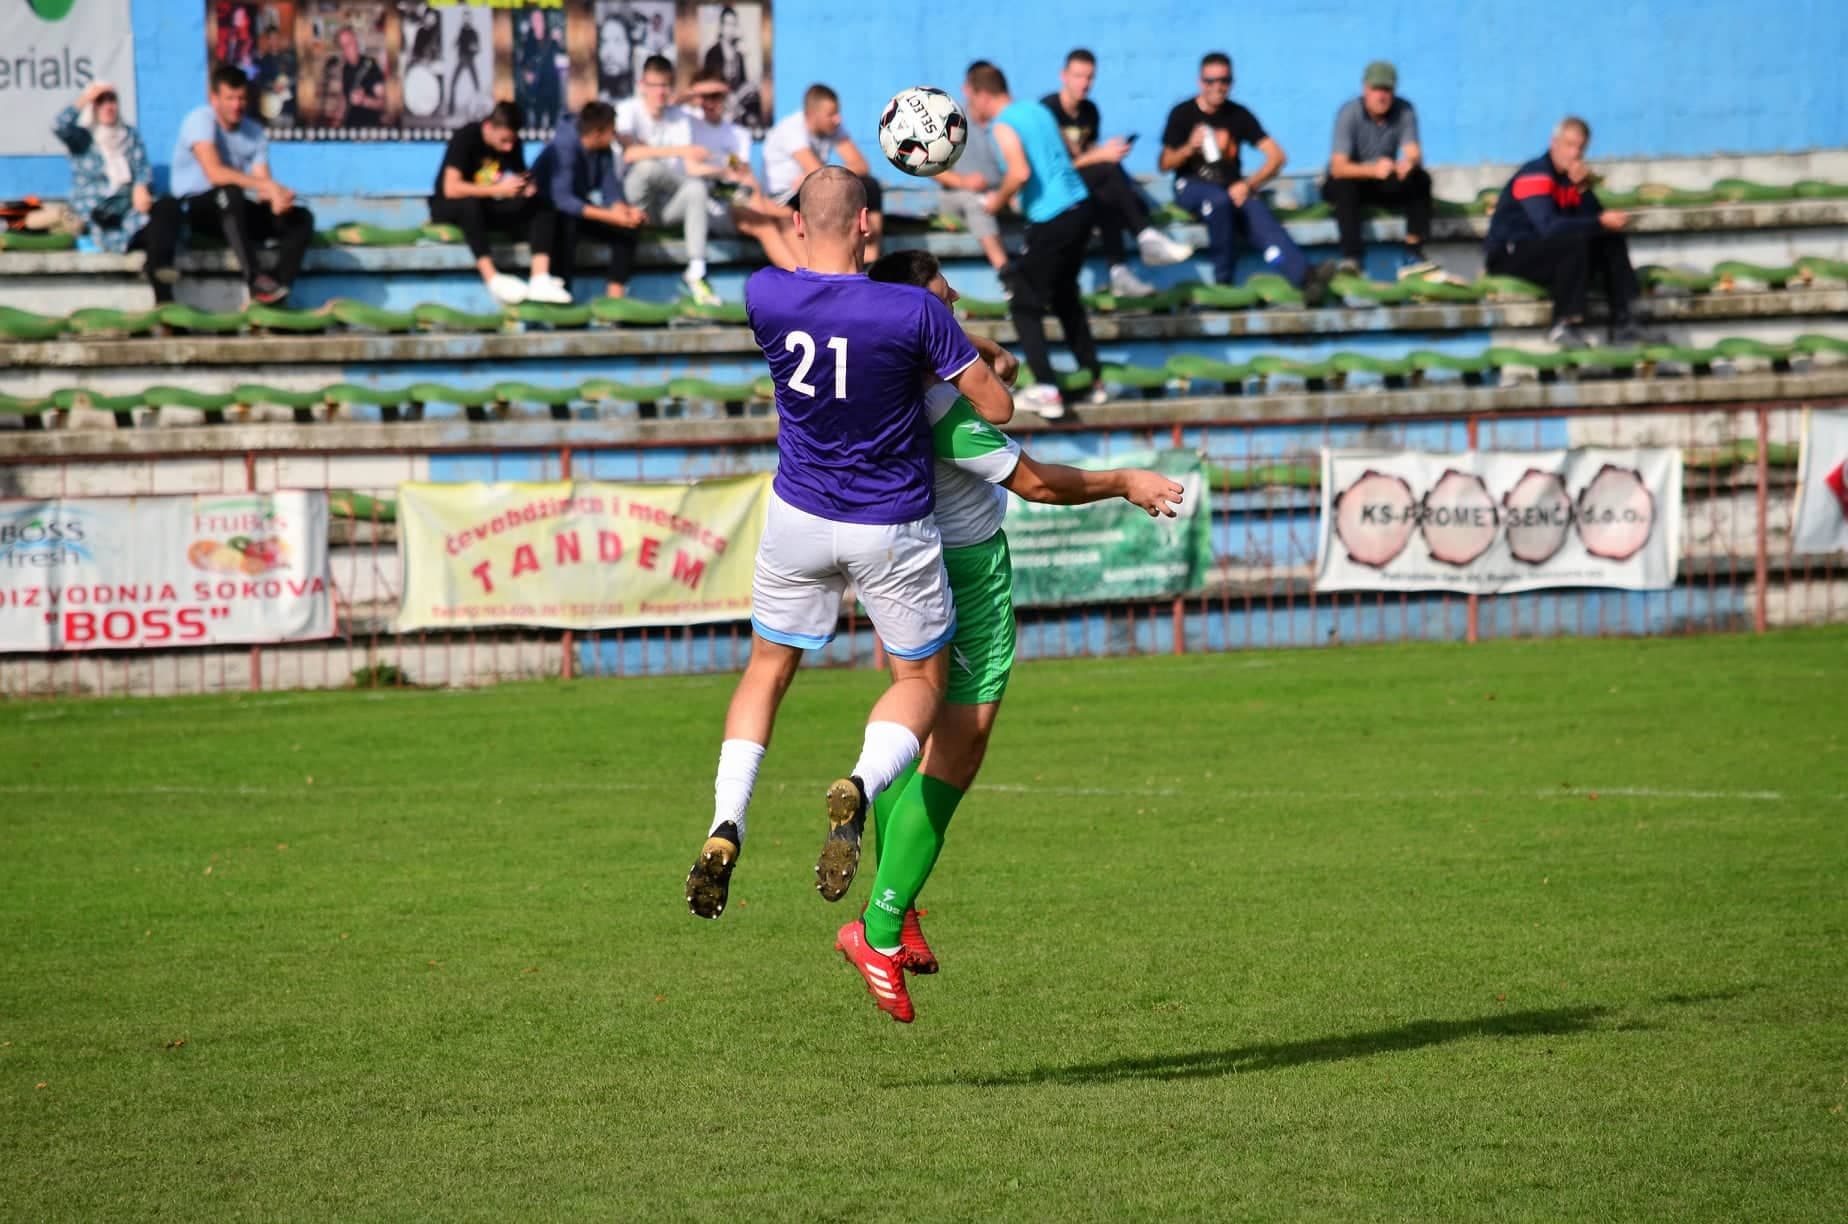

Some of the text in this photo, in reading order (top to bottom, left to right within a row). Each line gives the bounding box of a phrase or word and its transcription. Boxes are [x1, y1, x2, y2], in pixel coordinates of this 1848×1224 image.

[906, 94, 938, 134] SELECT
[785, 330, 848, 399] 21
[471, 529, 707, 595] TANDEM
[194, 576, 325, 603] SOKOVA
[45, 607, 229, 643] "BOSS"
[875, 898, 900, 915] ZEUS
